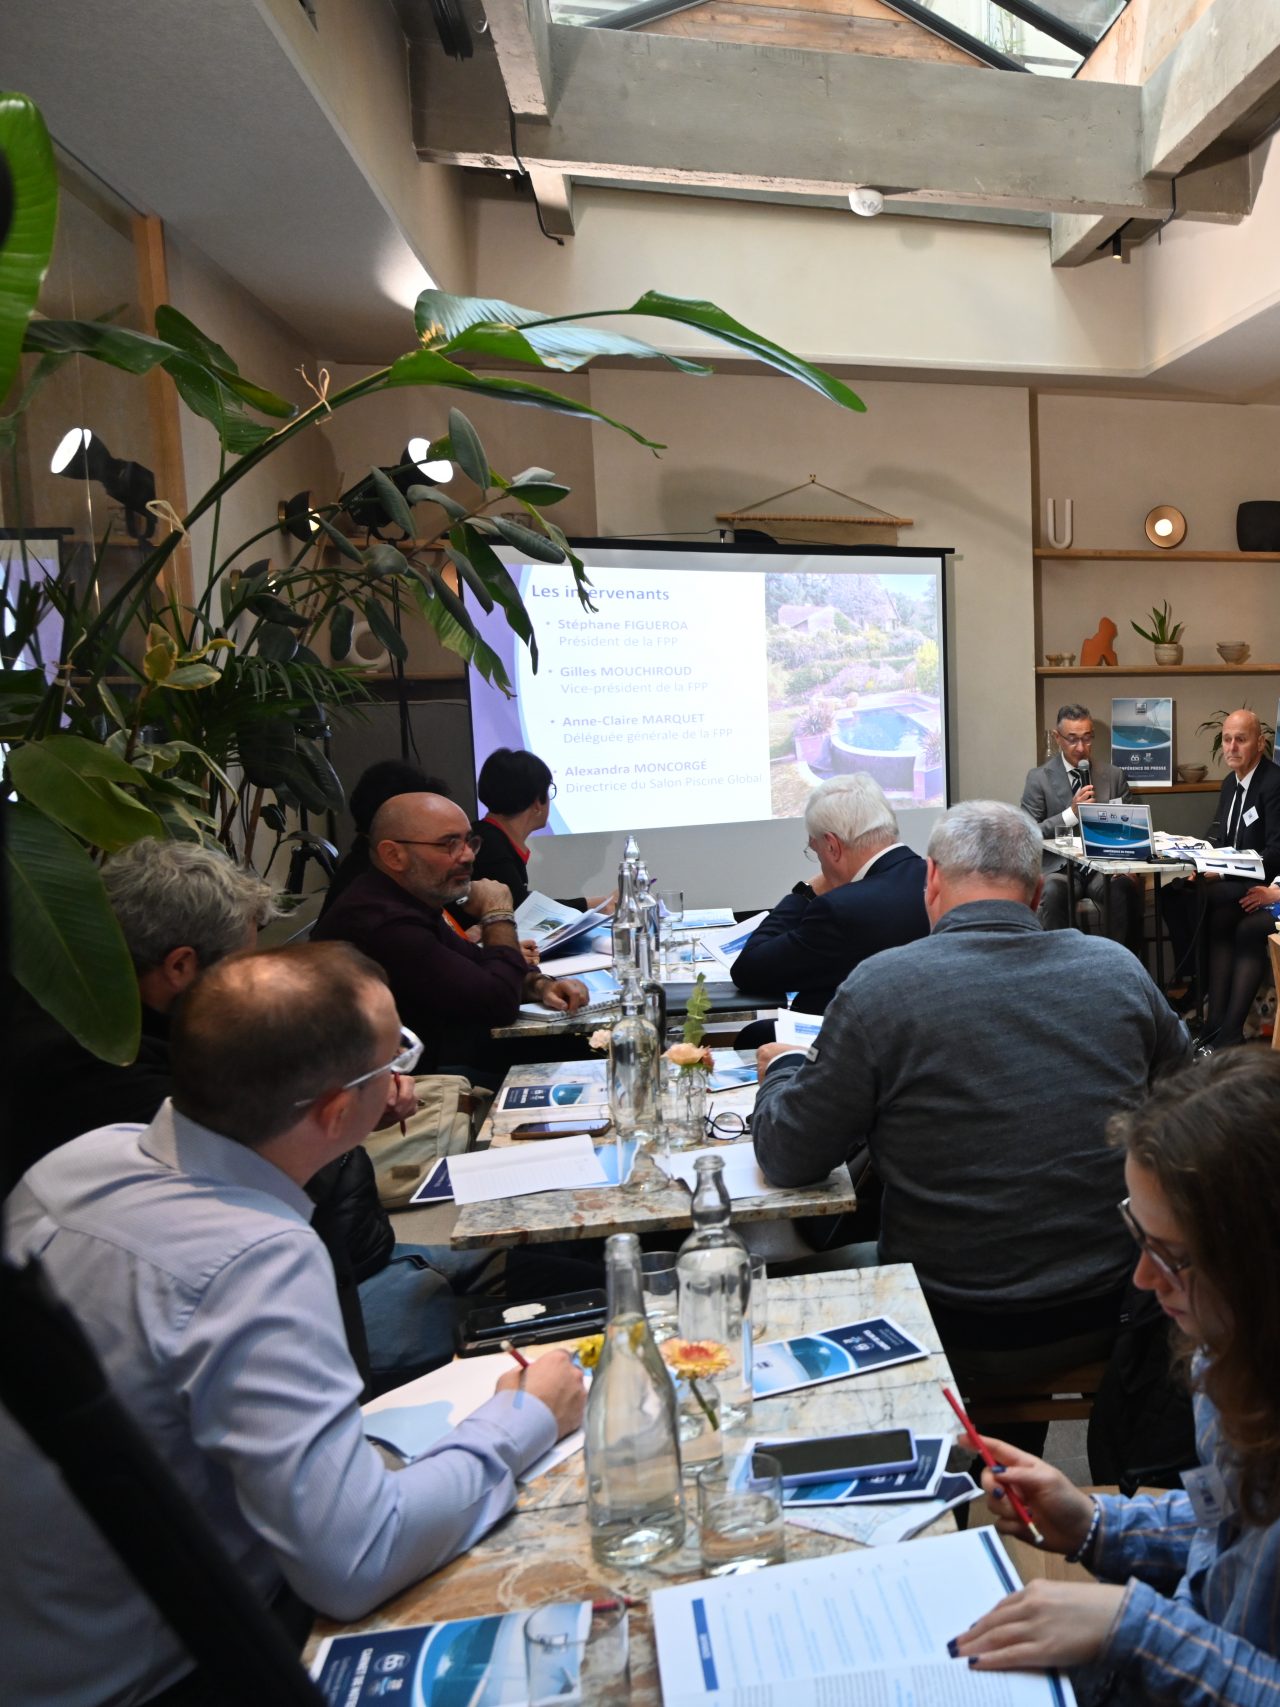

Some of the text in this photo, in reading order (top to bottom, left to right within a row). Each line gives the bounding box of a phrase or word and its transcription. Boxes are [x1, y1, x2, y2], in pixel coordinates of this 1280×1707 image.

[532, 585, 670, 600] Les inervenants
[558, 619, 688, 632] Stéphane FIGUEROA
[559, 636, 679, 647] Président de la FPP
[560, 666, 692, 677] Gilles MOUCHIROUD
[560, 681, 708, 696] Vice-président de la FPP
[562, 713, 705, 727] Anne-Claire MARQUET
[563, 727, 733, 745] Déléguée générale de la FPP
[564, 763, 631, 777] Alexandra
[566, 773, 762, 794] Directrice du Salon Piscine Global
